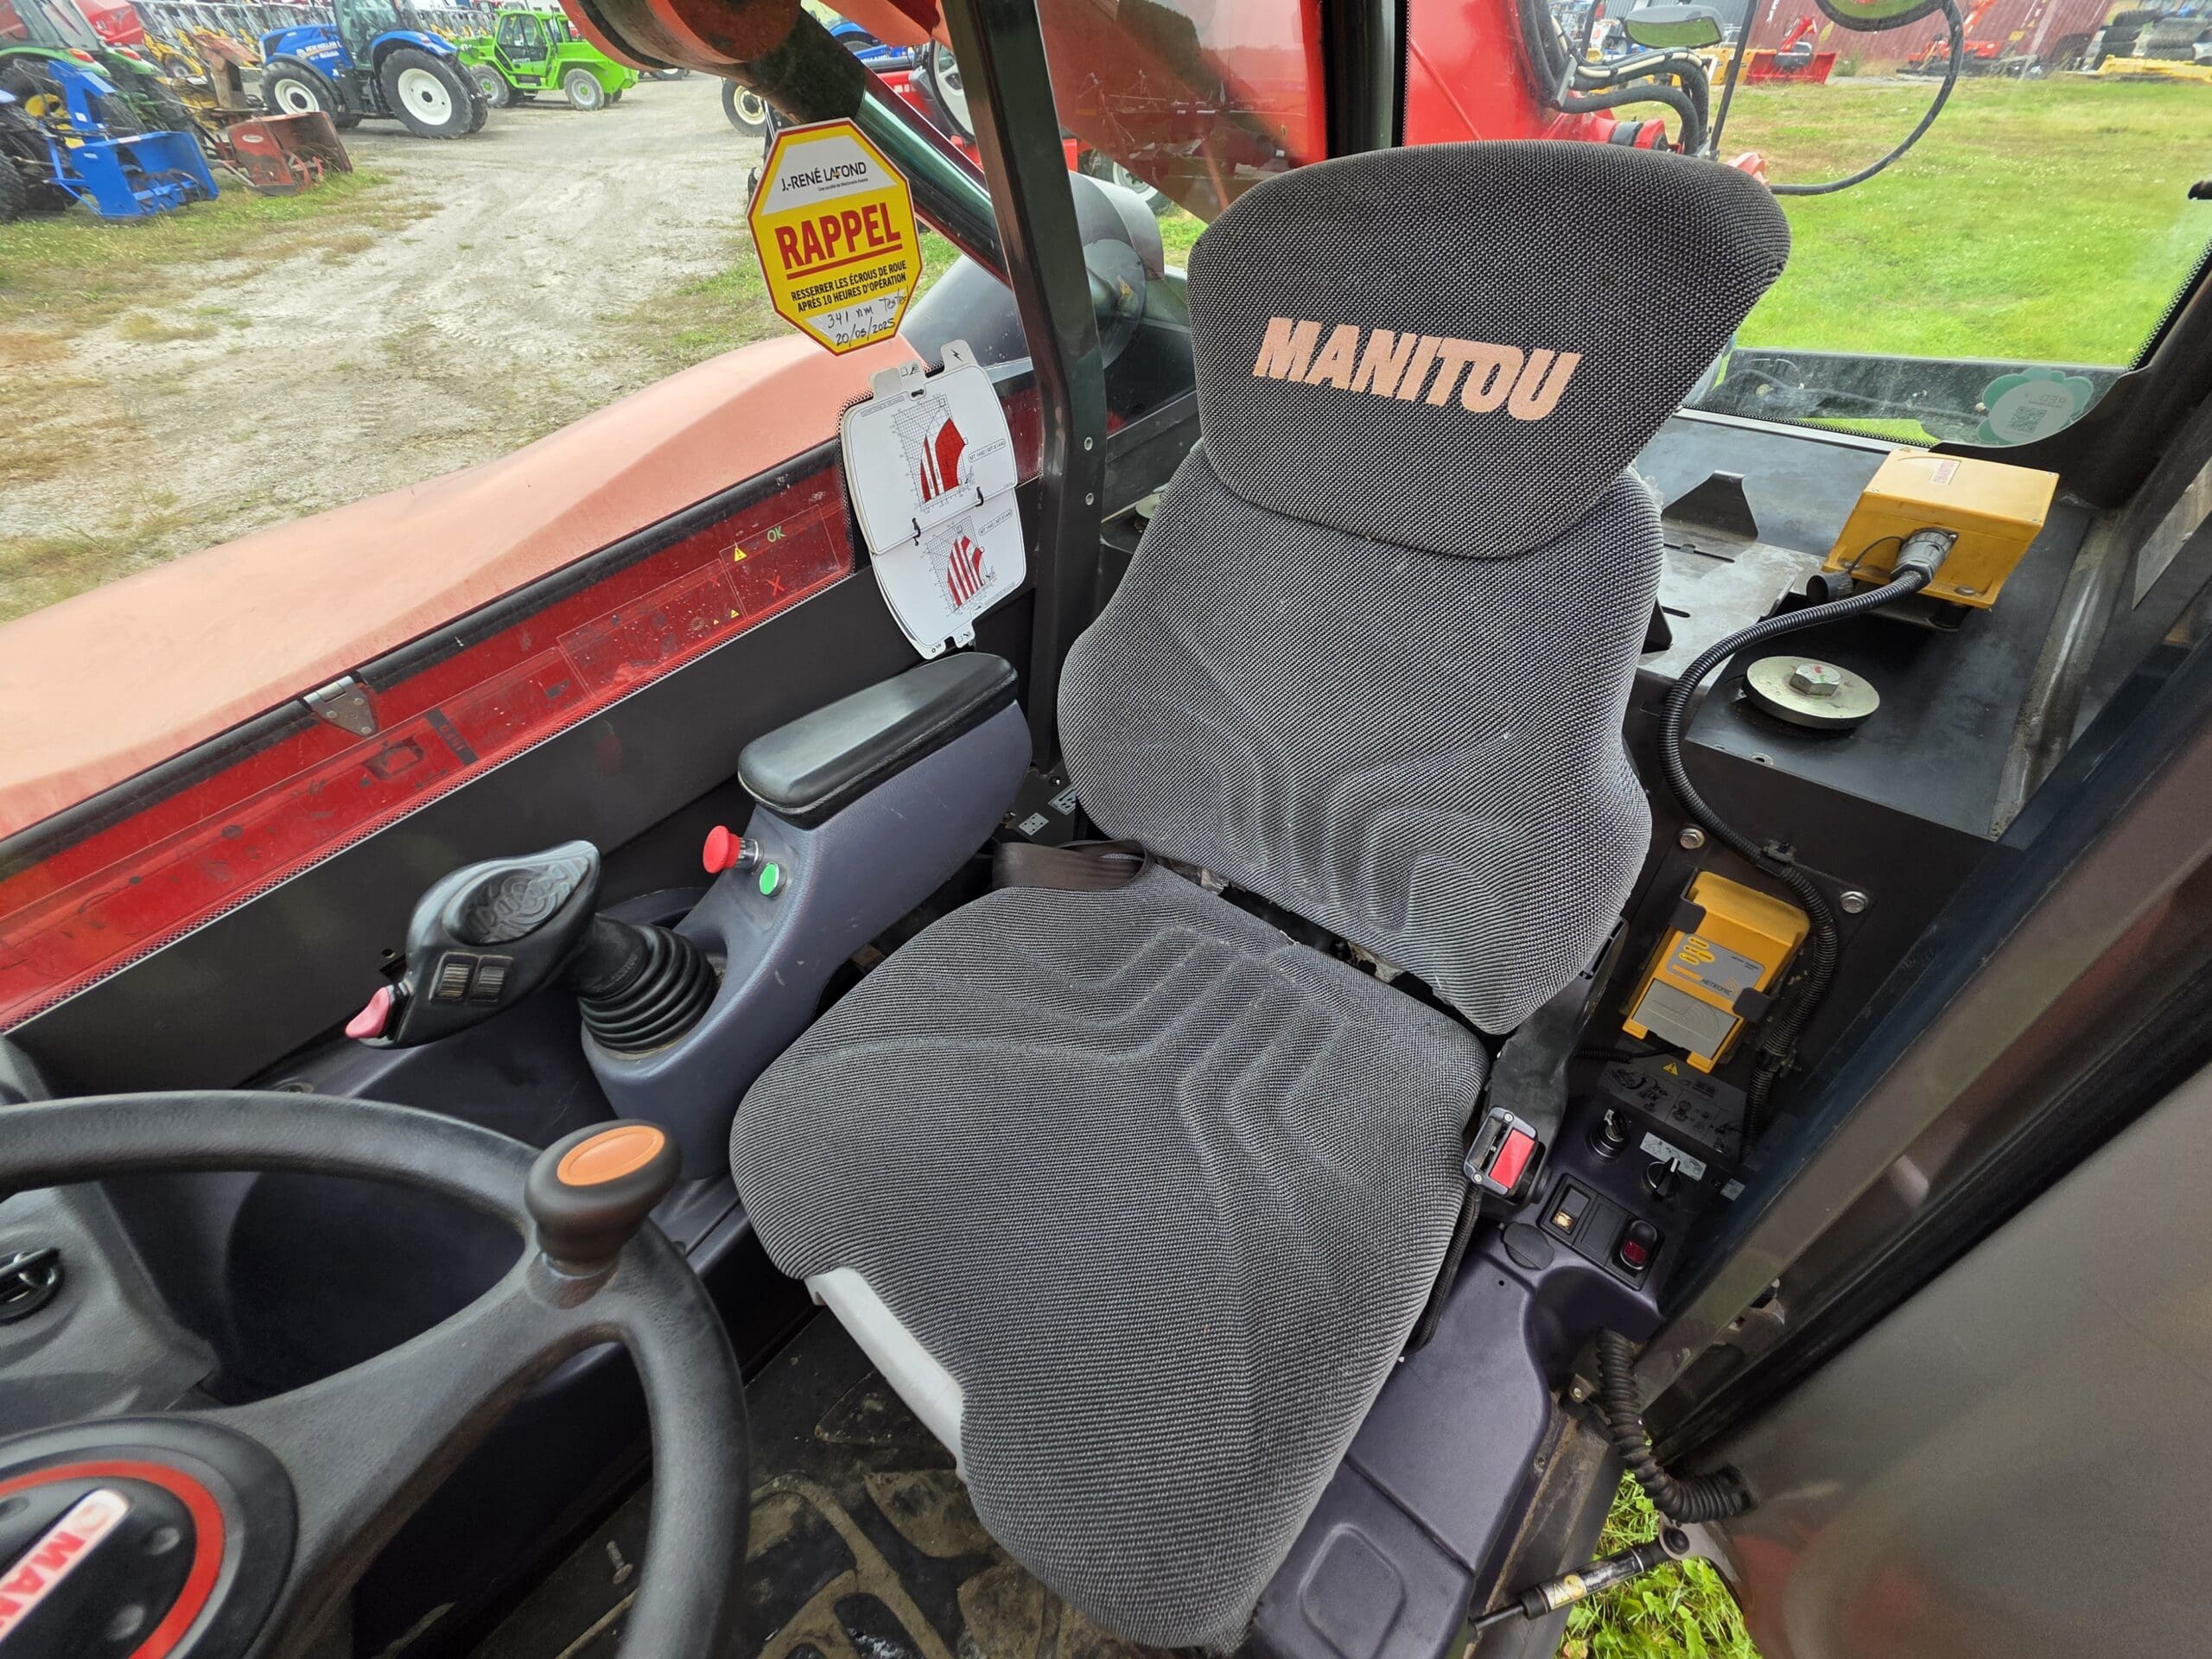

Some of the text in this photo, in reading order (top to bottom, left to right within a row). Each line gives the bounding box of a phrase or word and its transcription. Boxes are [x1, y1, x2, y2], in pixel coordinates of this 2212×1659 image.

[781, 162, 867, 191] J.-RENÉ LAFOND
[774, 202, 901, 270] RAPPEL
[791, 260, 907, 302] RESSERRER LES ÉCROUS DE ROUE
[798, 272, 906, 312] APRÈS 10 HEURES D'OPÉRATION
[827, 311, 849, 328] 341
[836, 316, 896, 347] 20/05/2025
[1253, 316, 1581, 421] MANITOU
[767, 525, 787, 543] OK
